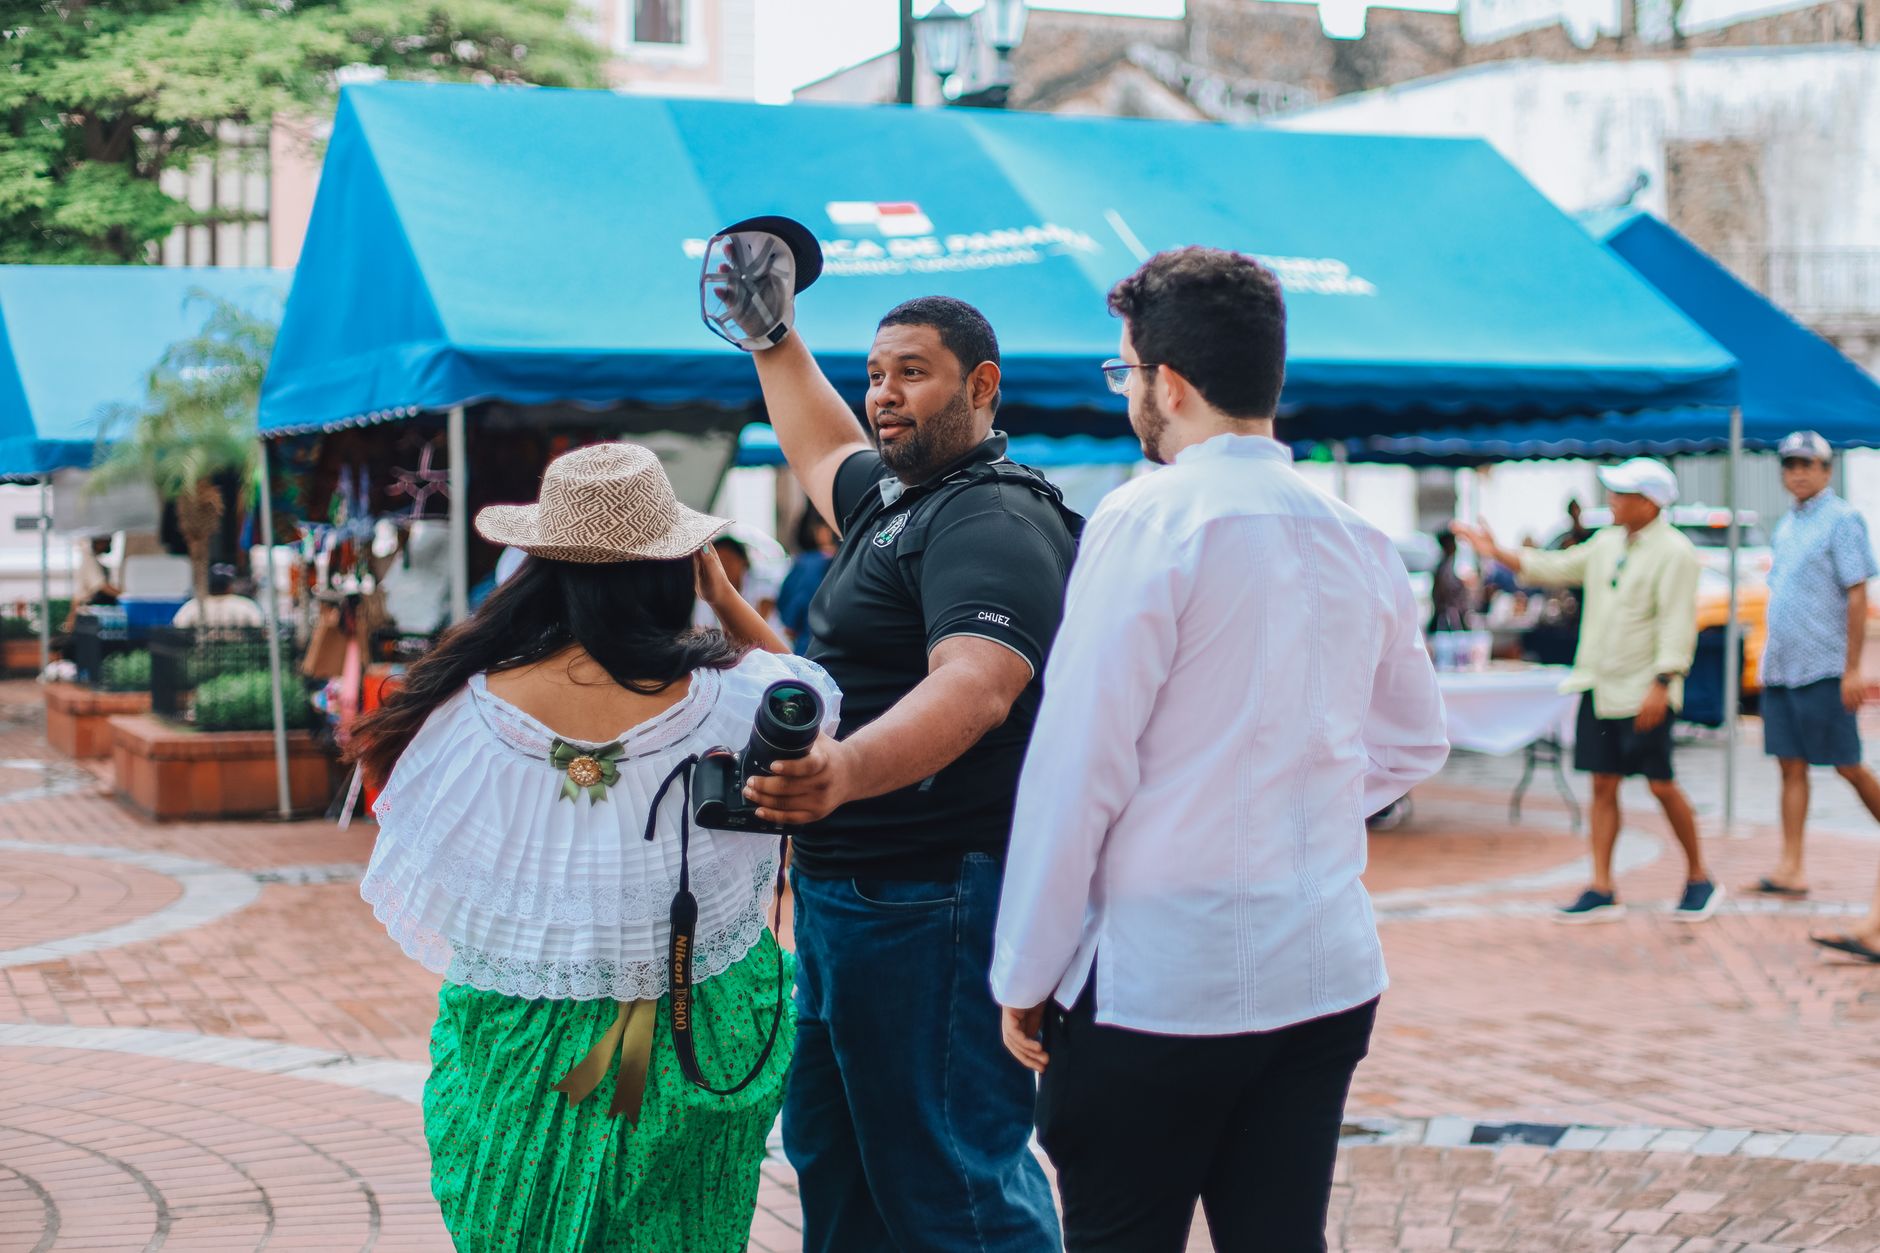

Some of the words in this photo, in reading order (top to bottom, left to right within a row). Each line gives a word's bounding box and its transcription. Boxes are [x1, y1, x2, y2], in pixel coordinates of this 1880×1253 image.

[978, 611, 1010, 627] CHUEZ
[674, 935, 688, 984] Nikon
[674, 988, 688, 1030] D800
